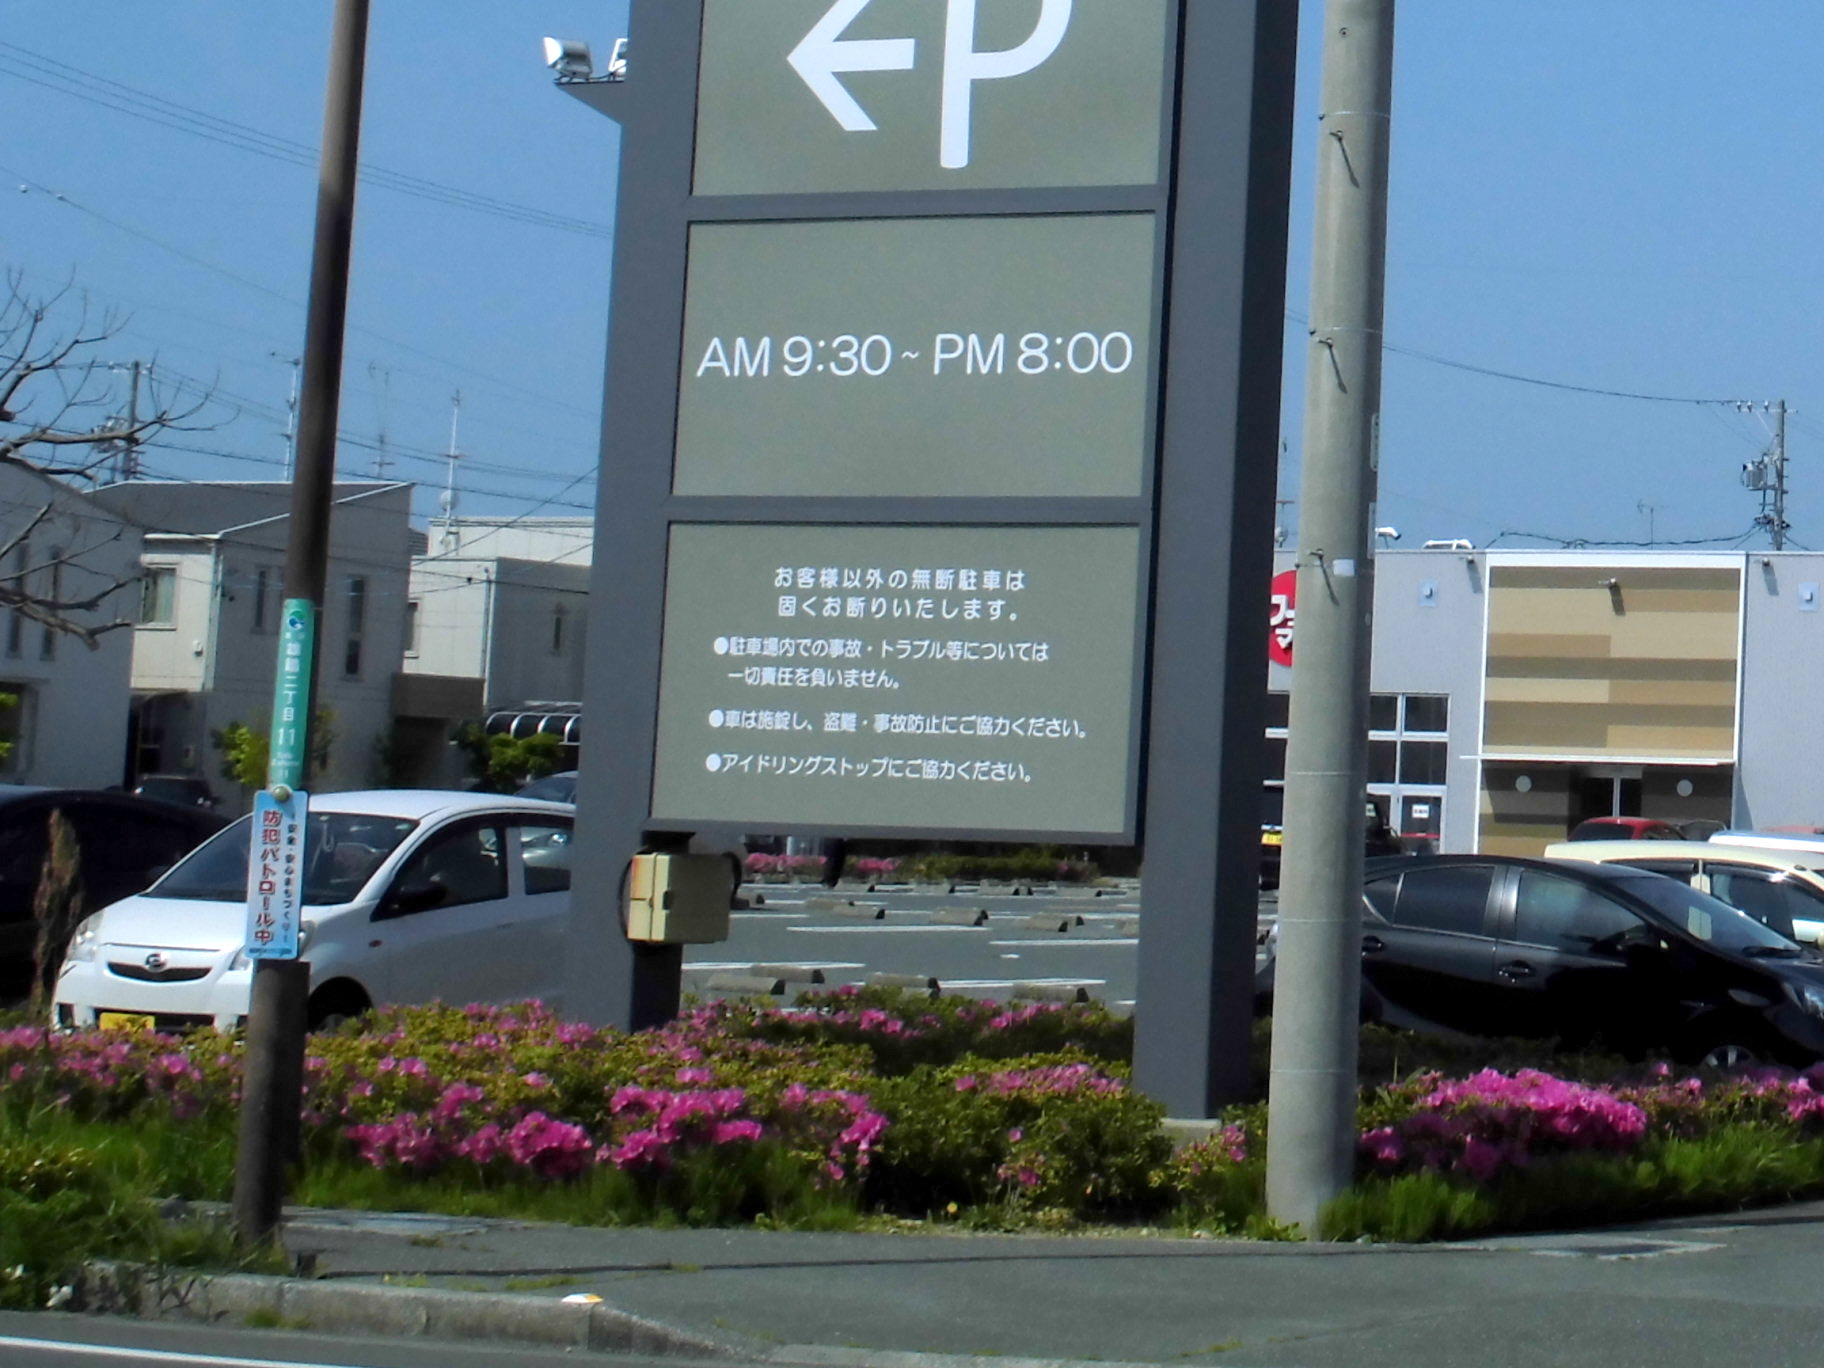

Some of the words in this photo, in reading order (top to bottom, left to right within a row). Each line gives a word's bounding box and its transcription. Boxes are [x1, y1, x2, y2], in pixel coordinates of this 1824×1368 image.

[697, 336, 770, 377] AM
[782, 334, 891, 376] 9:30
[933, 333, 1005, 375] PM
[1017, 331, 1133, 374] 8:00
[774, 567, 1025, 591] お客様以外の無断駐車は
[778, 596, 1019, 621] 固くお断りいたします。
[728, 667, 900, 689] 一切責任を負いません。
[721, 753, 1032, 783] アイドリングストップにご協力ください。
